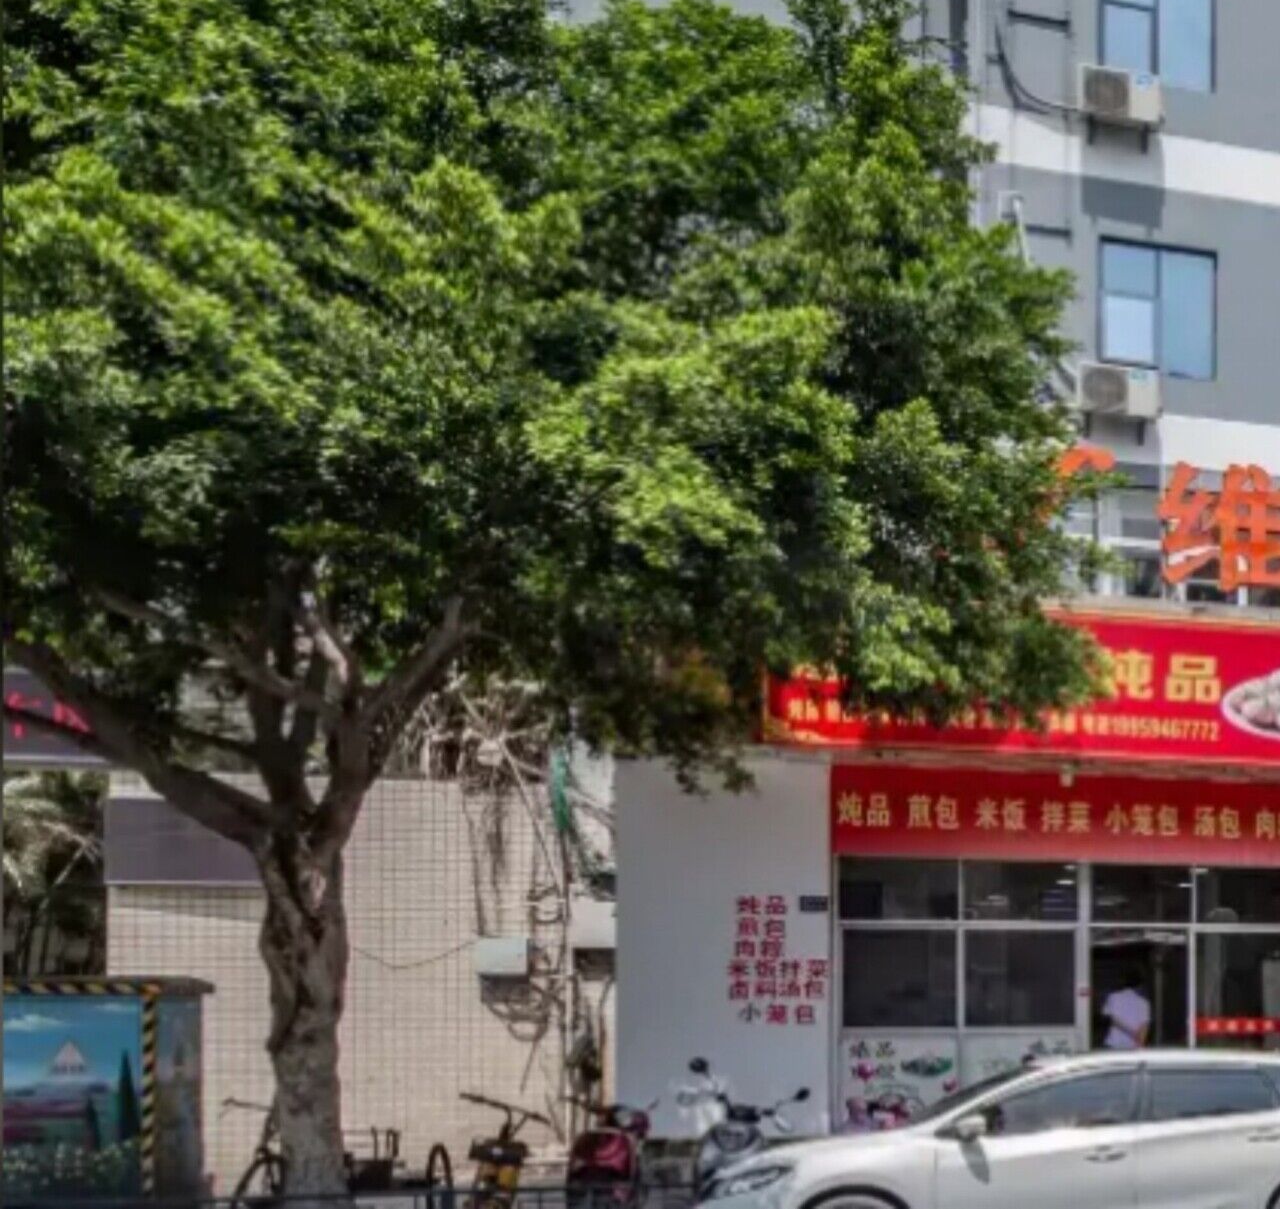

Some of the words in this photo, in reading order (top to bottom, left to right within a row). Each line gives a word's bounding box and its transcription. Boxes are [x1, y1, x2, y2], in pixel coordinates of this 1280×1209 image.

[838, 790, 890, 826] 炖品
[907, 793, 959, 829] 煎包
[974, 797, 1026, 830] 米饭
[1105, 803, 1179, 836] 小笼包
